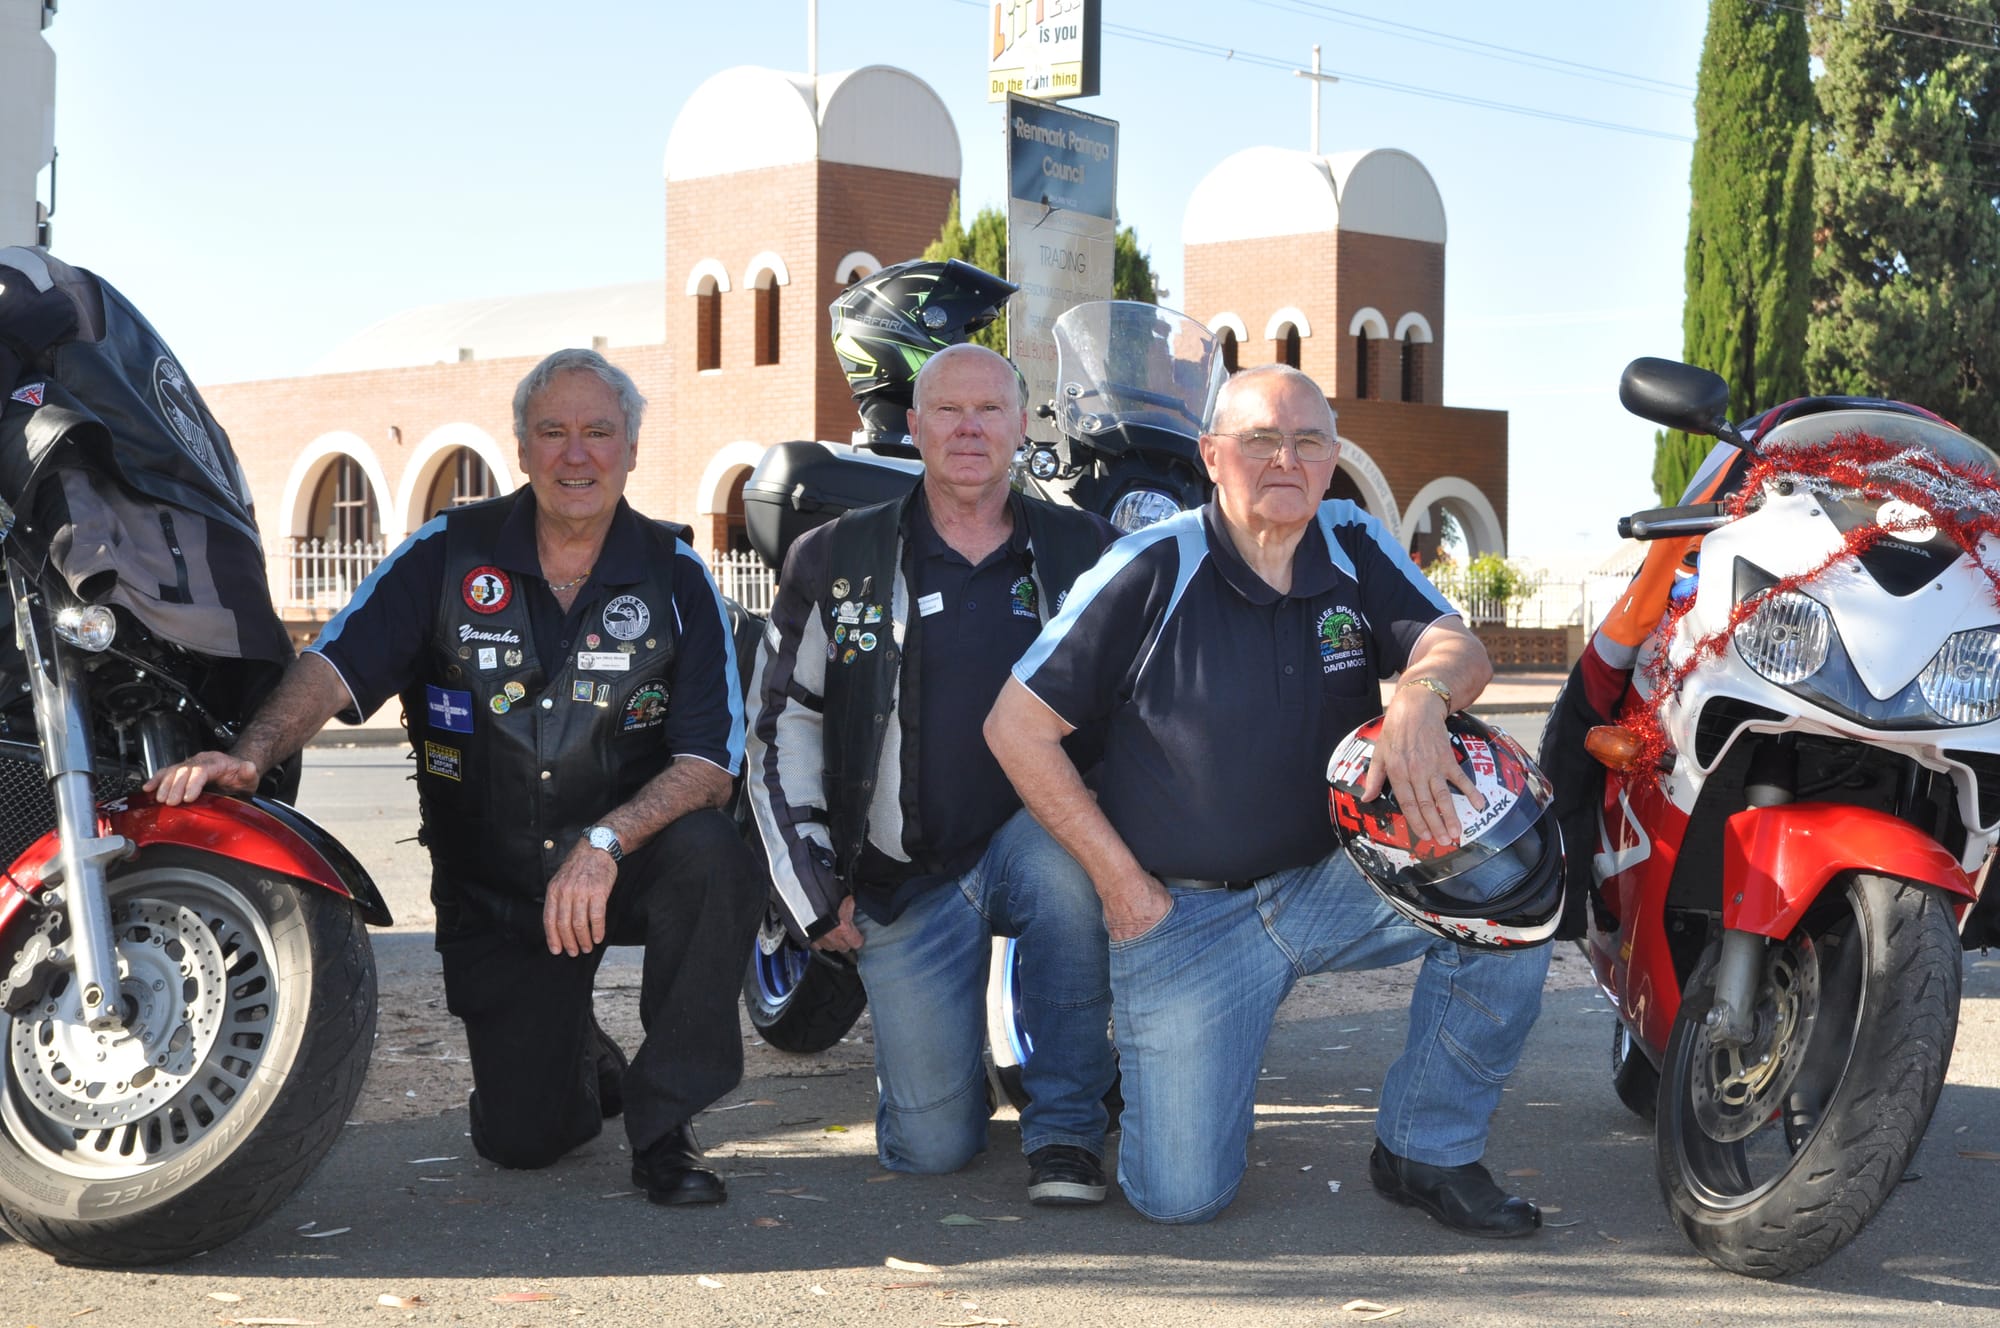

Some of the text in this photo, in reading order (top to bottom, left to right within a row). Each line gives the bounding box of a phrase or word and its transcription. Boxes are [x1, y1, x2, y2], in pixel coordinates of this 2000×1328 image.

[1039, 25, 1077, 43] is you
[992, 73, 1077, 93] Do the rht thing
[1015, 116, 1109, 161] Renmark Paringa
[1042, 155, 1085, 184] Council
[1040, 245, 1086, 274] TRADING
[855, 314, 905, 331] SAFARI
[1876, 540, 1932, 558] HONDA
[1336, 605, 1362, 630] BRANCH
[458, 624, 521, 643] Yamaha
[1323, 661, 1346, 674] DAVID
[1464, 794, 1511, 838] SHARK
[97, 1089, 261, 1207] CRUISETEC
